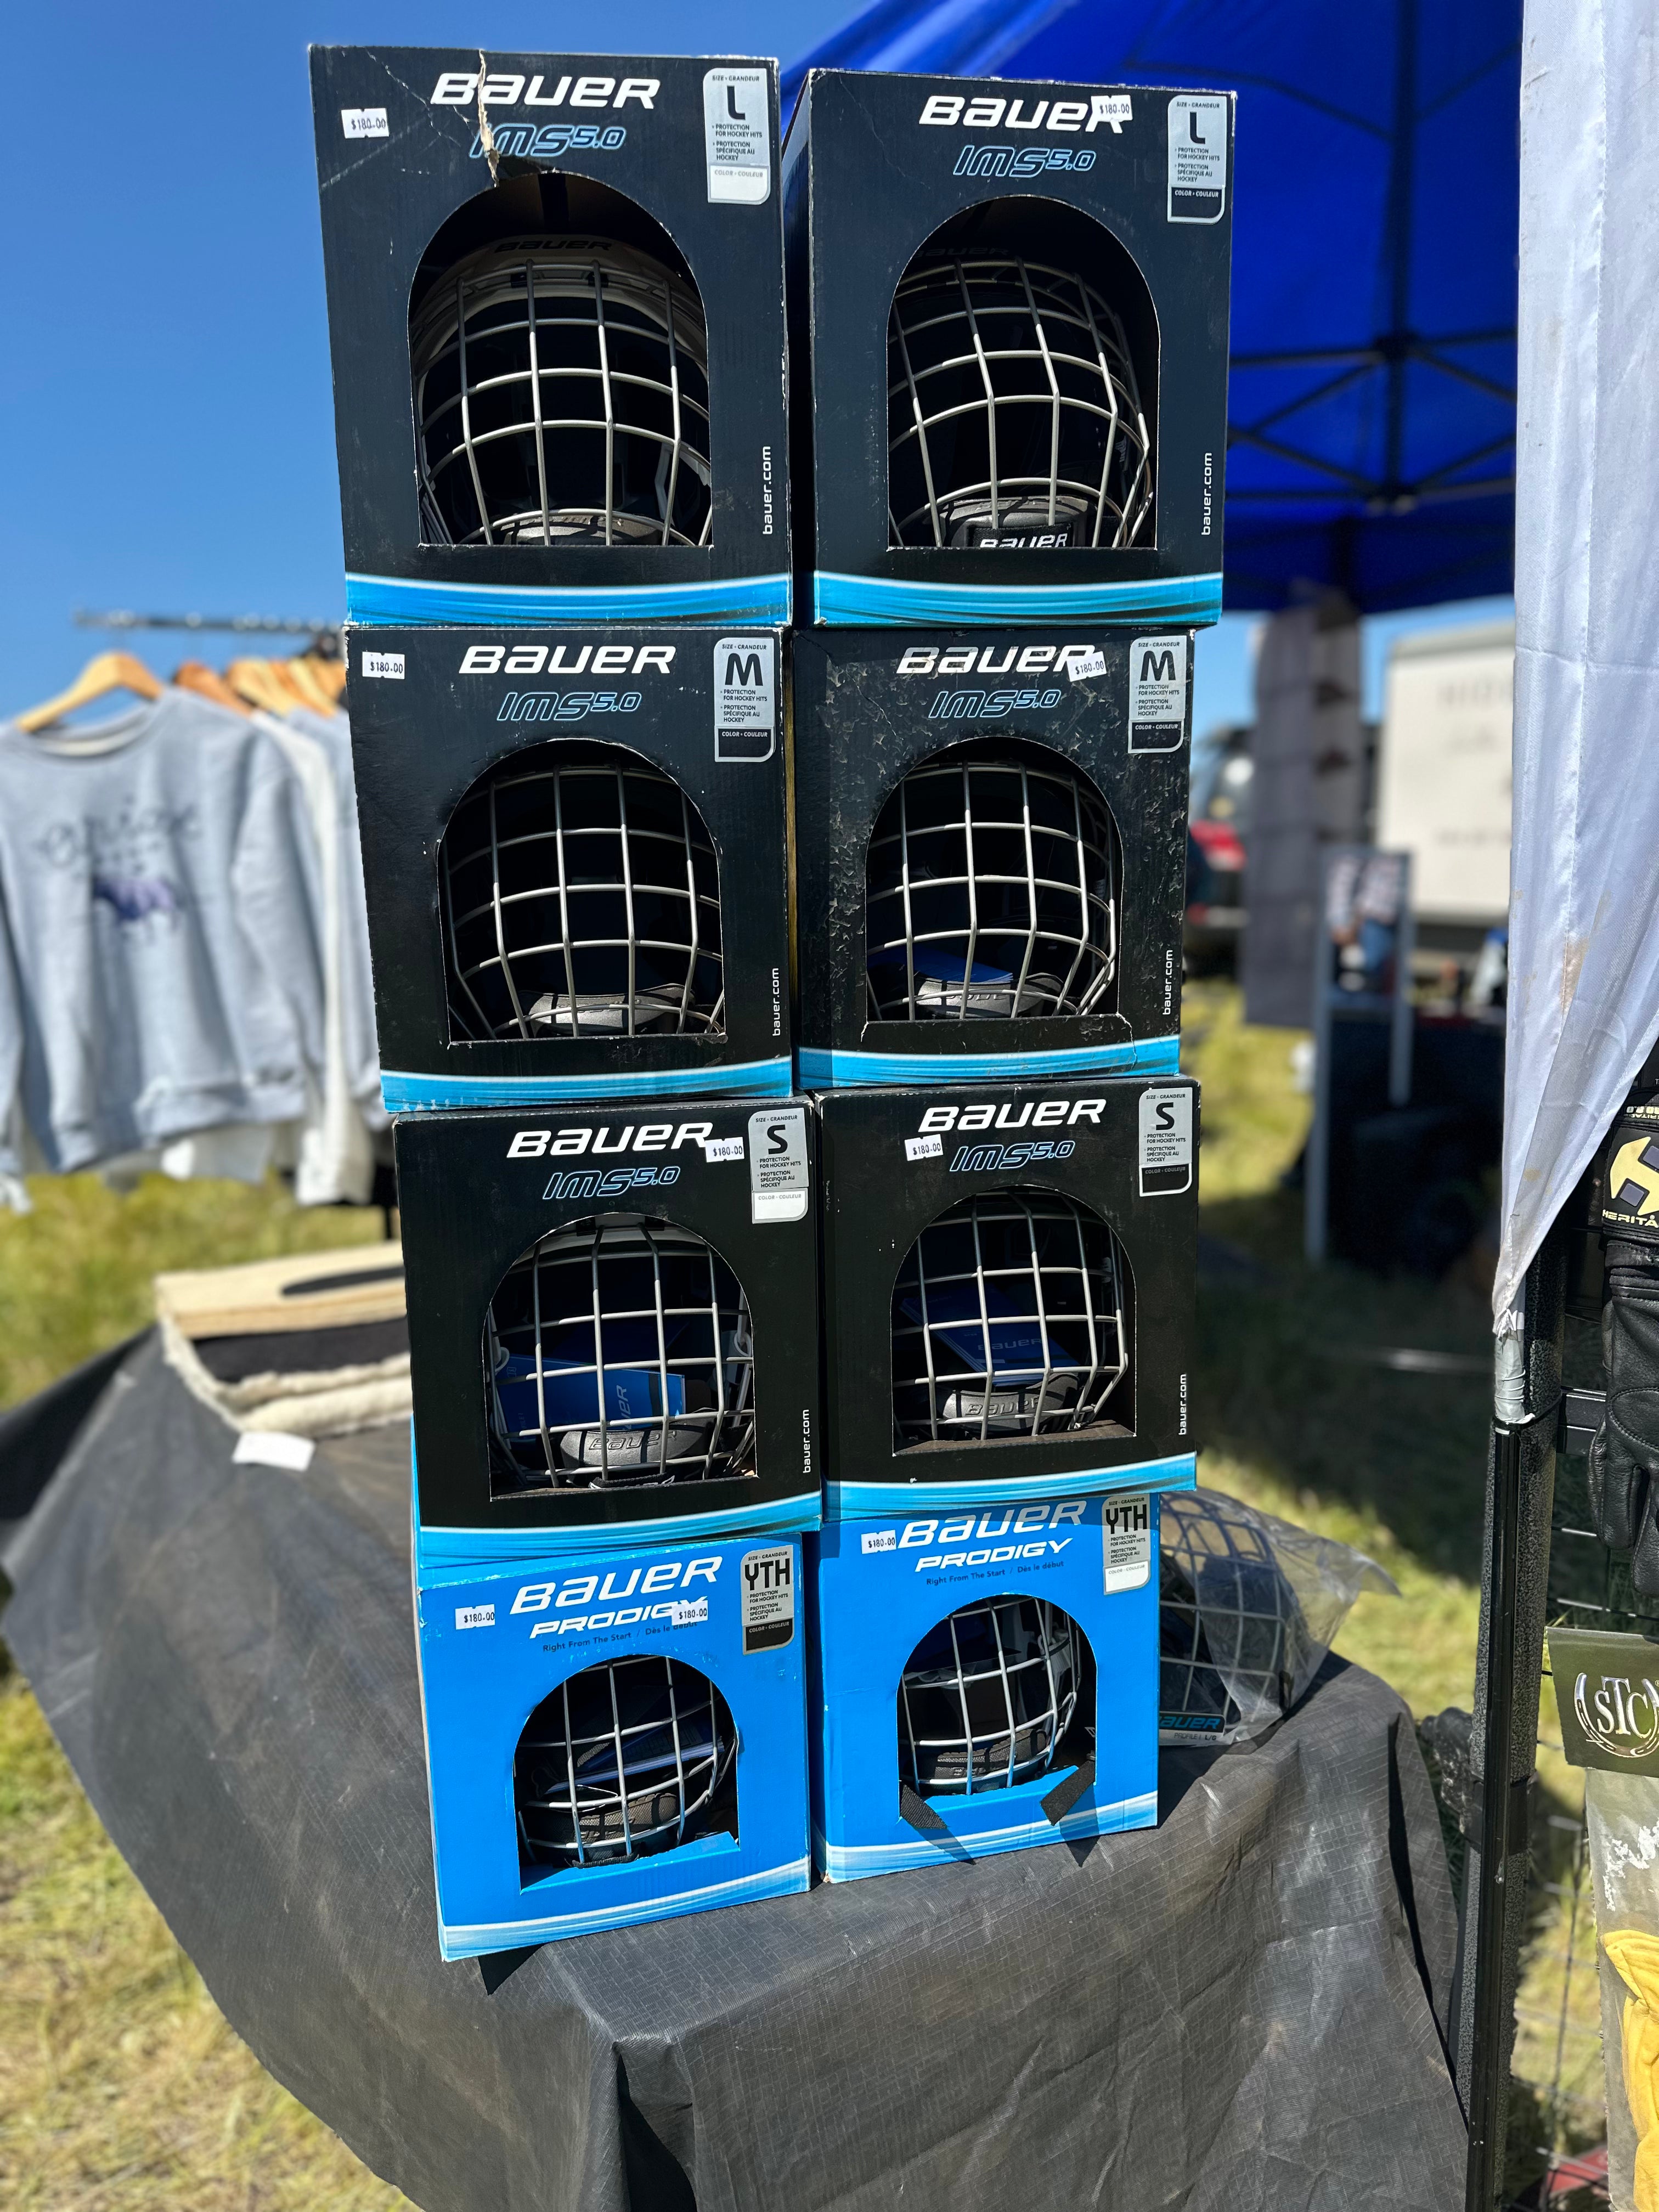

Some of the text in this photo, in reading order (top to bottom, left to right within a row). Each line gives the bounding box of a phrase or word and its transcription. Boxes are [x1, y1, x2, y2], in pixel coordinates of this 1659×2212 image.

[431, 72, 660, 109] BAUER
[727, 86, 746, 120] L
[1100, 103, 1129, 114] $180.00
[351, 118, 386, 131] $180.00
[1190, 112, 1205, 144] L
[494, 241, 612, 253] BAUER
[763, 446, 772, 534] bauer.com
[1201, 453, 1212, 535] bauer.com
[370, 662, 403, 674] $180.00
[459, 646, 676, 674] BAUER
[725, 653, 763, 686] M
[1076, 661, 1104, 675] $180.00
[1140, 650, 1176, 681] M
[1163, 950, 1173, 1014] bauer.com
[772, 968, 781, 1036] bauer.com
[918, 1099, 1107, 1132] BAUER
[1156, 1102, 1174, 1130] S
[506, 1122, 713, 1158] BAUER
[713, 1145, 743, 1156] $180.00
[768, 1125, 788, 1154] S
[913, 1143, 941, 1155] $180.00
[1602, 1209, 1659, 1228] HERITA
[803, 1409, 811, 1473] bauer.com
[898, 1500, 1087, 1549] BAUER
[1106, 1504, 1147, 1534] YTH
[868, 1537, 895, 1548] $180.00
[915, 1538, 1073, 1572] PRODIGY
[510, 1556, 723, 1615] BAUER
[745, 1558, 790, 1590] YTH
[927, 1577, 947, 1585] Right
[950, 1573, 968, 1582] From
[987, 1569, 1005, 1577] Start
[1018, 1564, 1031, 1573] Dès
[1042, 1560, 1064, 1570] début
[750, 1590, 778, 1598] PROTECTION
[751, 1602, 778, 1611] PROTECTION
[464, 1611, 495, 1623] $180.00
[679, 1608, 707, 1620] $180.00
[543, 1642, 566, 1652] Right
[568, 1638, 590, 1648] From
[592, 1635, 609, 1644] The
[611, 1632, 631, 1641] Start
[645, 1626, 662, 1635] Dès
[1594, 1675, 1651, 1738] STC
[1159, 1716, 1221, 1729] AUER
